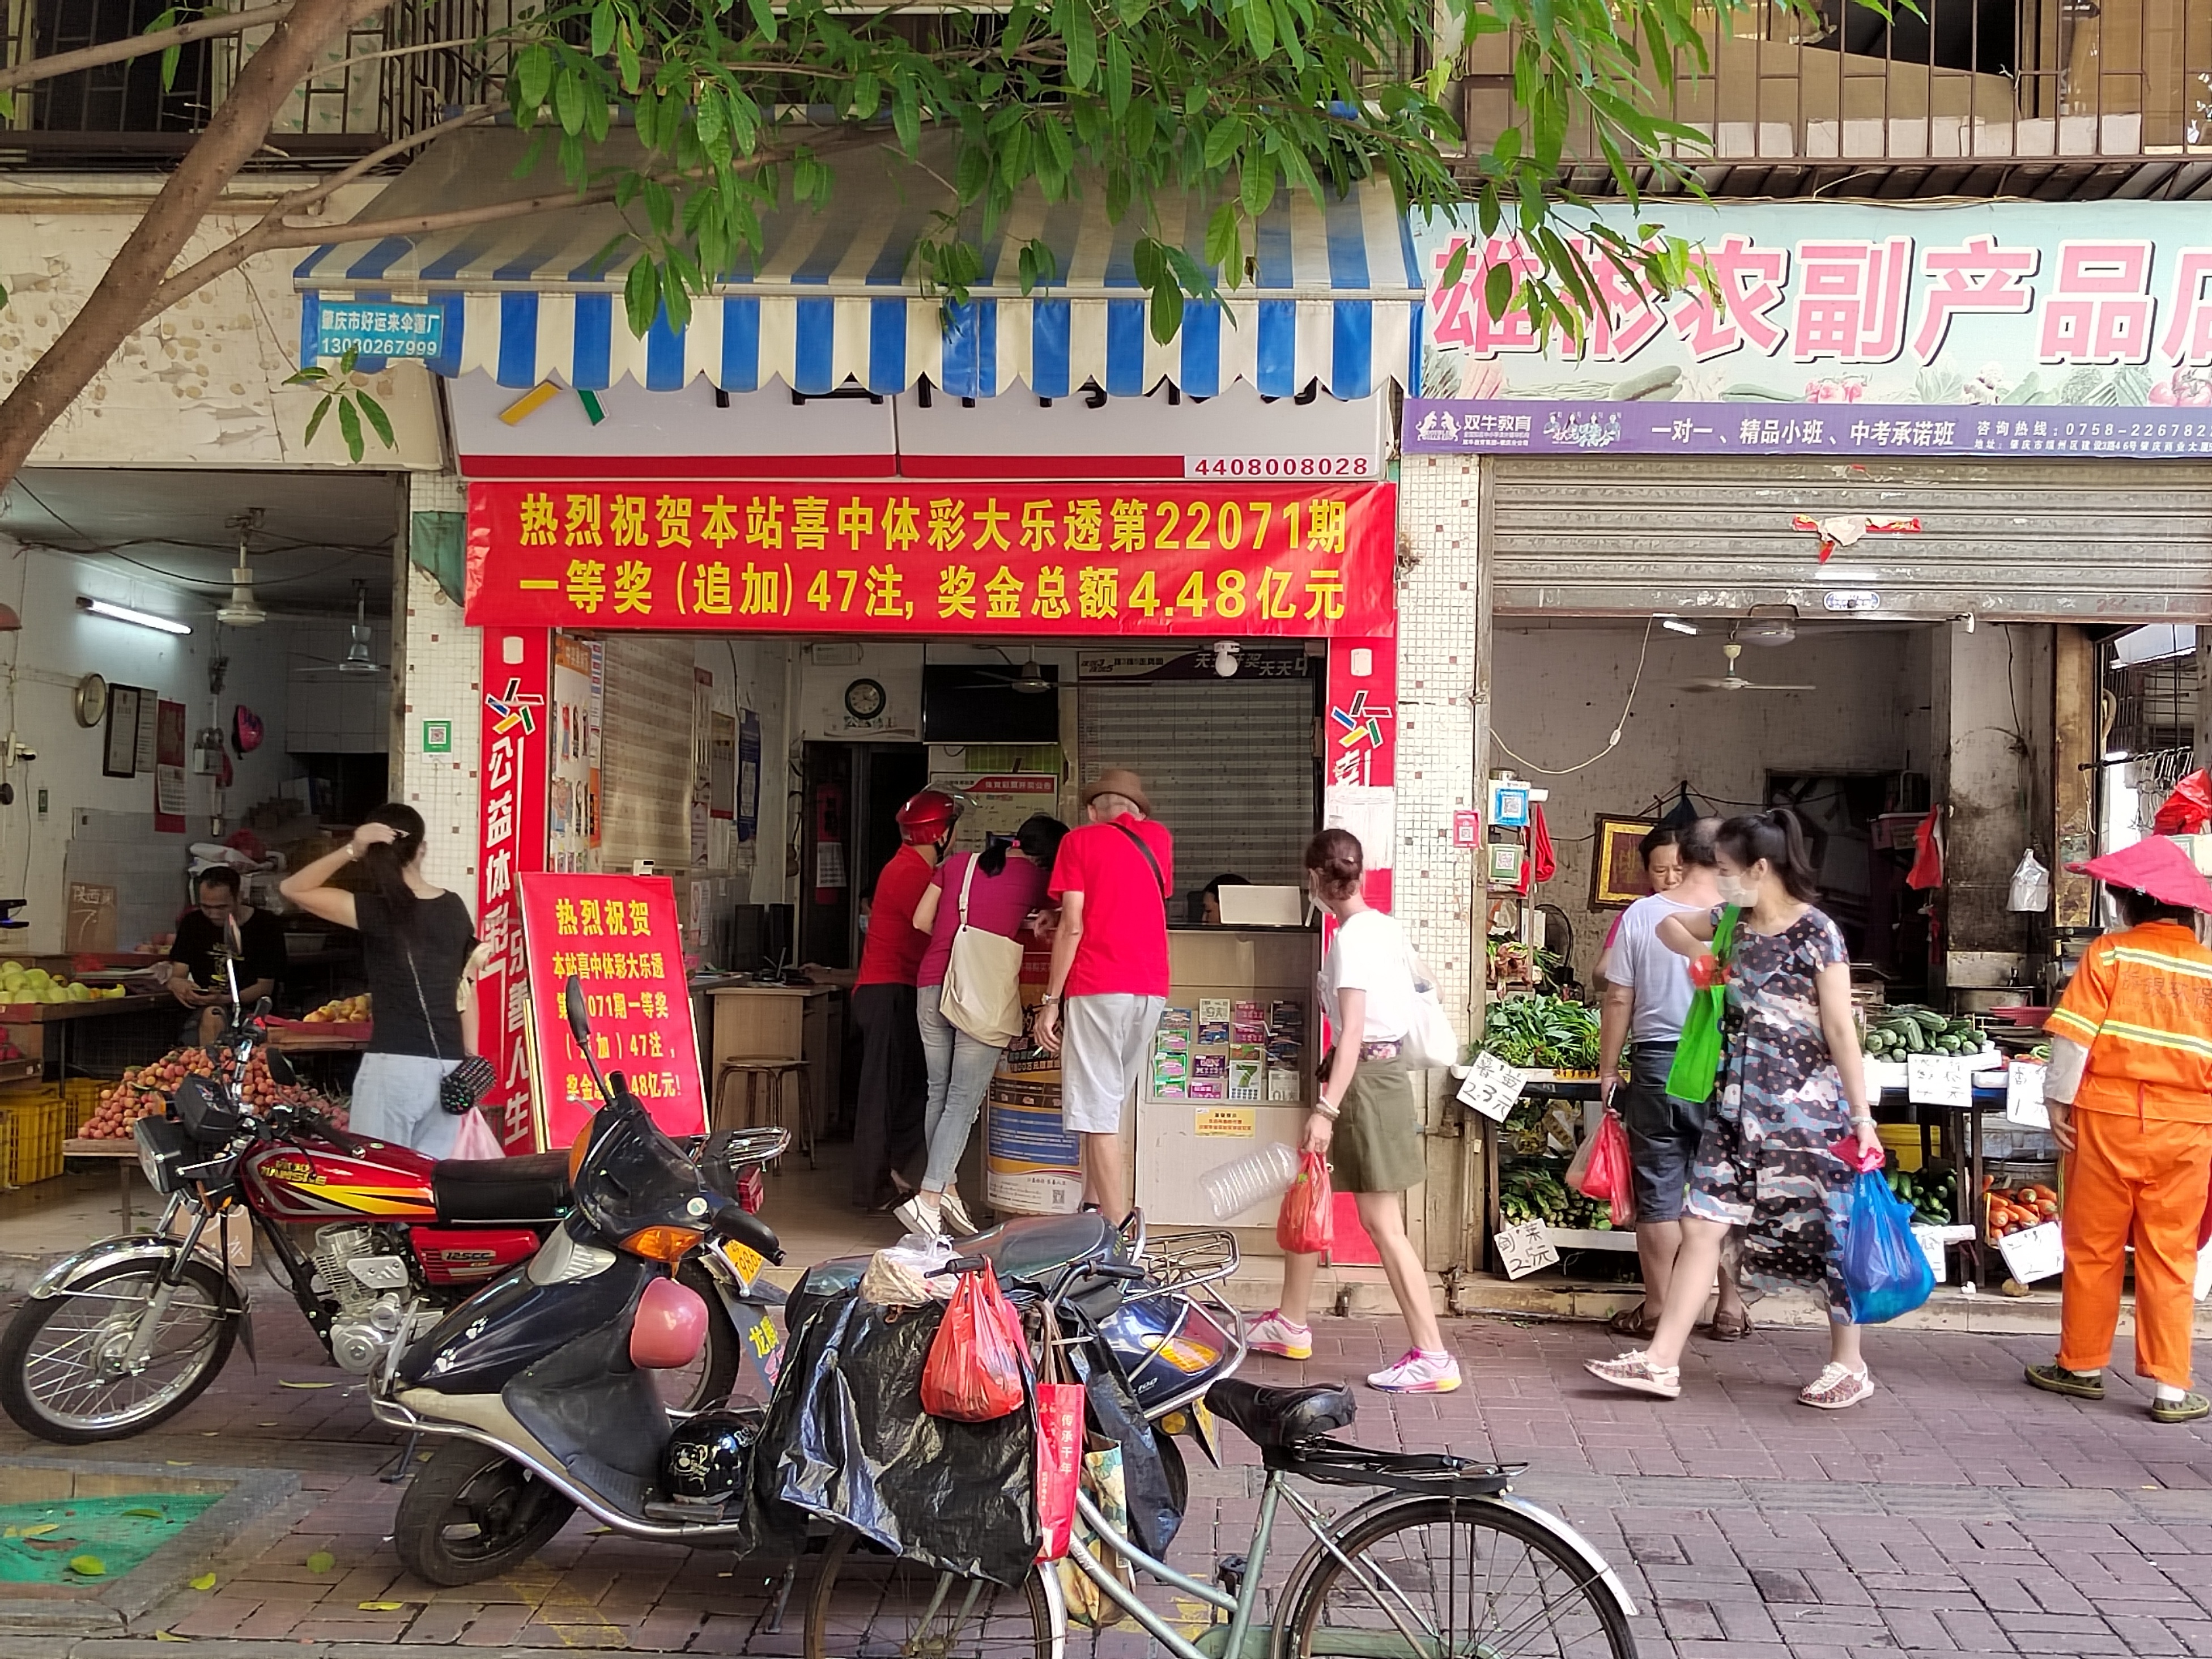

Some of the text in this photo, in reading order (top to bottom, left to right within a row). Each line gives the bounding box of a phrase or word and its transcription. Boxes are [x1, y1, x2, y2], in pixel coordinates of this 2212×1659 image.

[1464, 414, 1532, 431] 双牛教育
[1977, 420, 2212, 437] 咨询热线：0758-226782
[1194, 458, 1368, 476] 4408008028
[520, 493, 1347, 554] 热烈祝贺本站喜中体彩大乐透第22071期
[555, 899, 652, 937] 热烈祝贺
[552, 952, 665, 980] 本站喜中体彩大乐透
[1060, 1414, 1074, 1476] 传承千年
